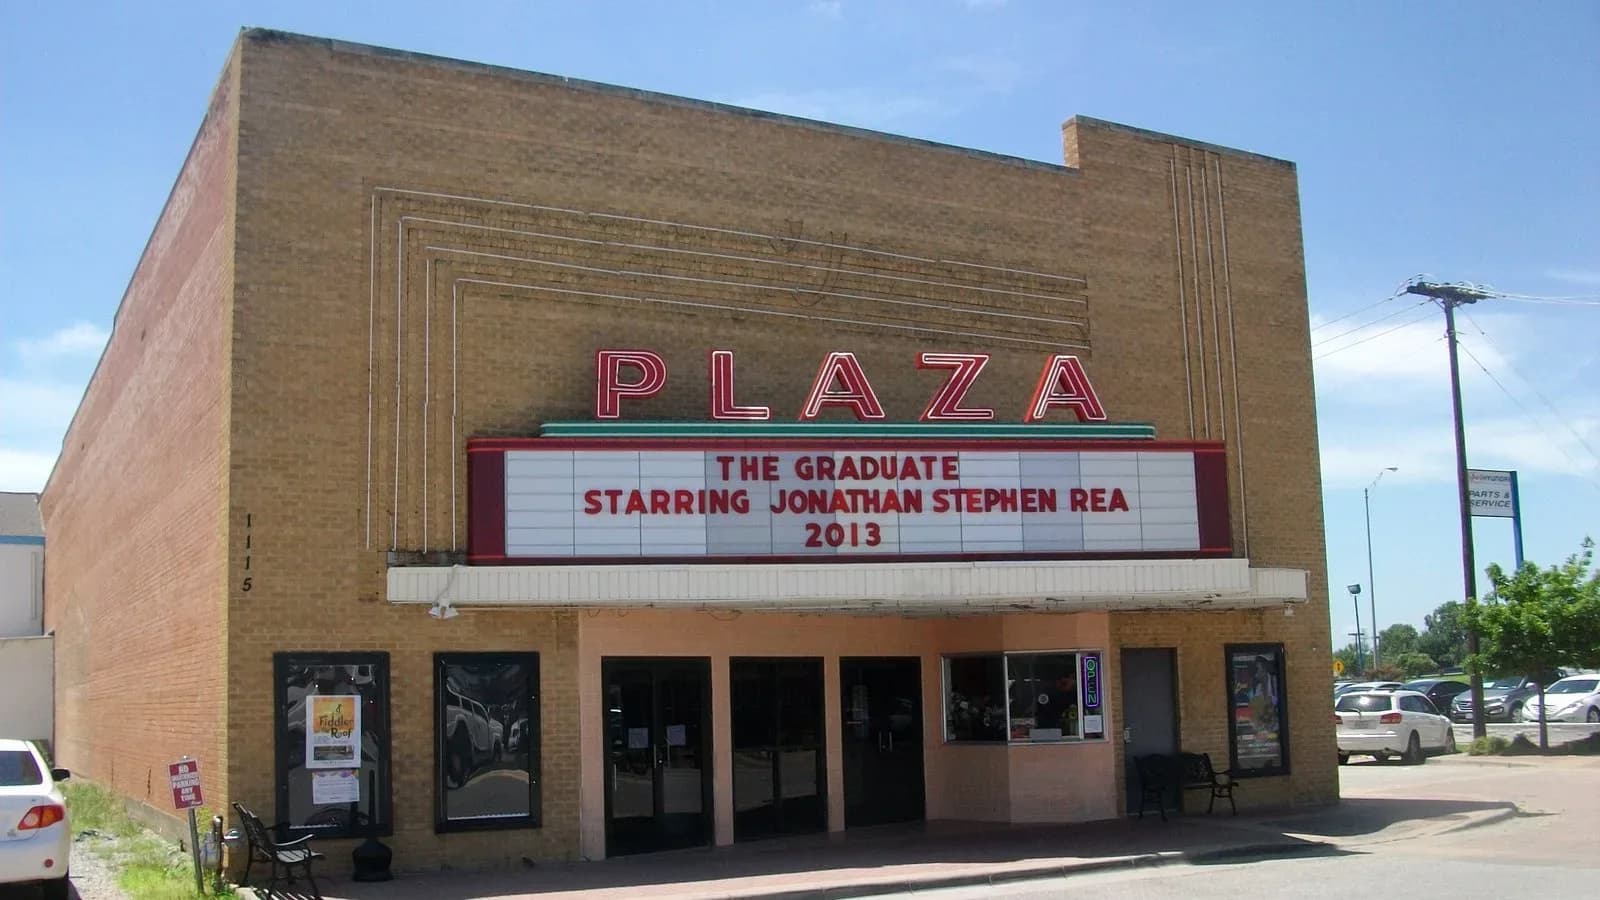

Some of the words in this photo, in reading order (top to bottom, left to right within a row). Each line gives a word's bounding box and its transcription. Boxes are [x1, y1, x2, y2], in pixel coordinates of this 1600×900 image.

[595, 350, 1107, 423] PLAZA
[716, 456, 779, 481] THE
[795, 456, 959, 481] GRADUATE
[584, 489, 749, 515] STARRING
[770, 488, 922, 514] JONATHAN
[933, 488, 1056, 513] STEPHEN
[1070, 488, 1128, 512] REA
[1469, 490, 1500, 498] PARTS
[805, 522, 881, 547] 2013
[242, 513, 252, 591] 1115
